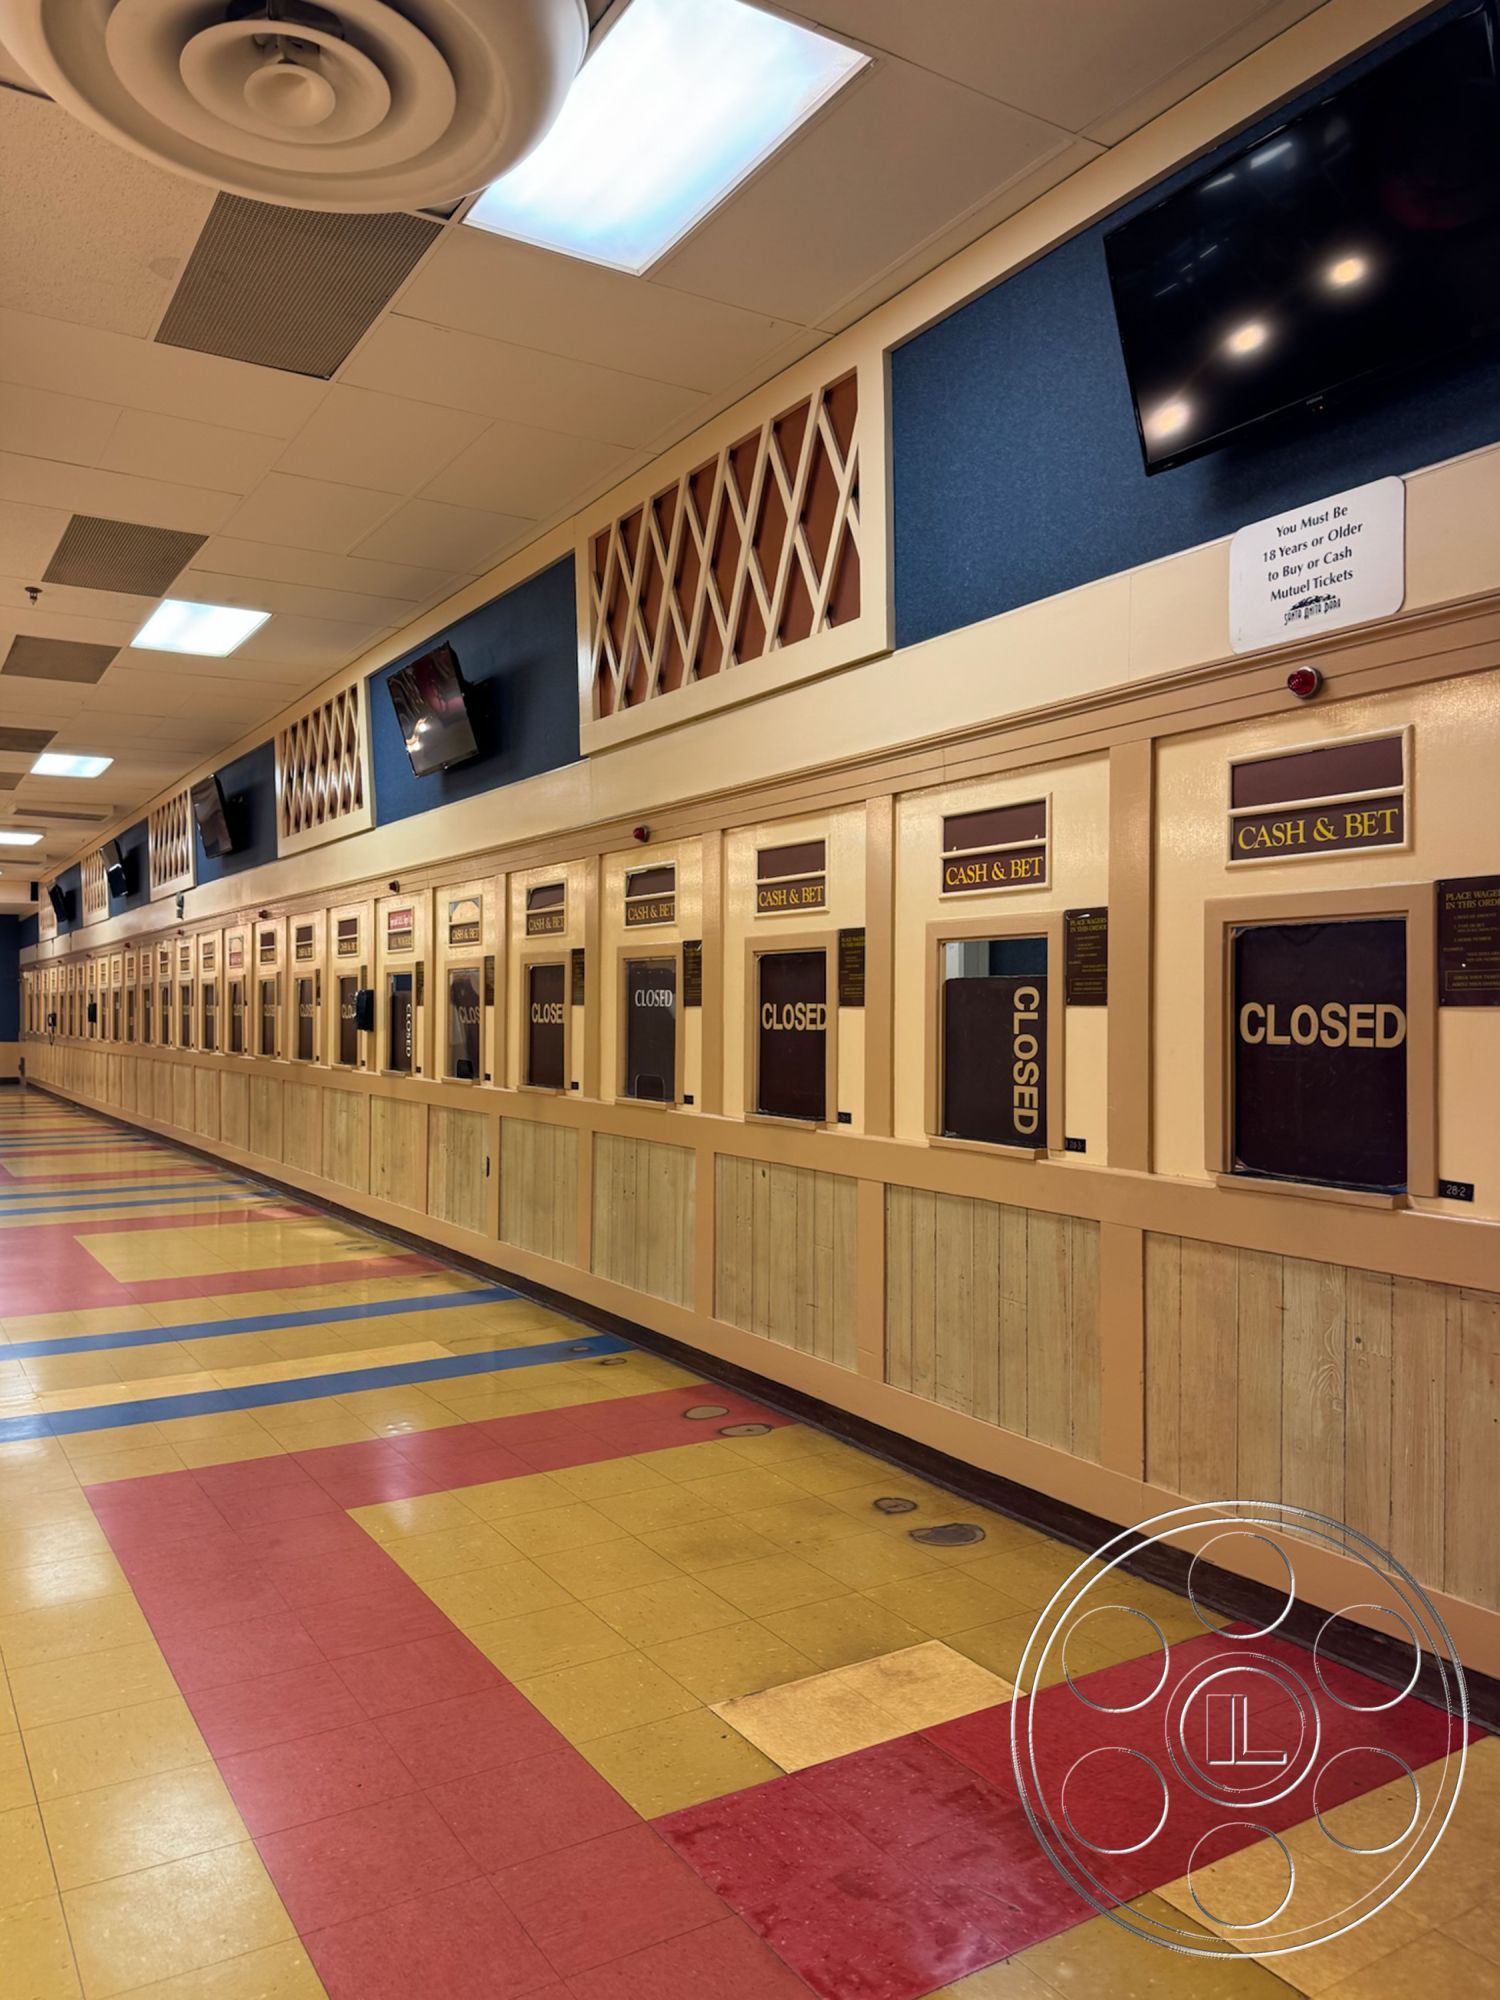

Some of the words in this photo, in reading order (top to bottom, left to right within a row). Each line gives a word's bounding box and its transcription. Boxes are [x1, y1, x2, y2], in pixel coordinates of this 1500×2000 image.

[1276, 523, 1297, 537] You
[1300, 511, 1329, 530] Must
[1333, 506, 1348, 519] Be
[1263, 549, 1276, 562] 18
[1279, 540, 1308, 557] Years
[1311, 536, 1324, 547] or
[1327, 523, 1363, 542] Older
[1268, 571, 1279, 581] to
[1282, 563, 1303, 577] Buy
[1307, 558, 1320, 570] or
[1323, 546, 1352, 564] Cash
[1270, 580, 1310, 601] Mutuel
[1312, 569, 1353, 589] Tickets
[1238, 820, 1306, 849] CASH
[1313, 817, 1339, 841] &
[1344, 808, 1399, 838] BET
[945, 863, 988, 885] CASH
[991, 861, 1007, 881] &
[1010, 856, 1043, 879] BET
[627, 905, 649, 920] CASH
[650, 905, 658, 918] &
[659, 903, 675, 917] BET
[758, 889, 787, 907] CASH
[789, 888, 799, 904] &
[802, 885, 823, 903] BET
[532, 1003, 564, 1023] CLOSE
[635, 990, 673, 1007] CLOSED
[762, 1002, 827, 1030] CLOSED
[1240, 1002, 1406, 1048] CLOSED
[1013, 986, 1040, 1135] CLOSED
